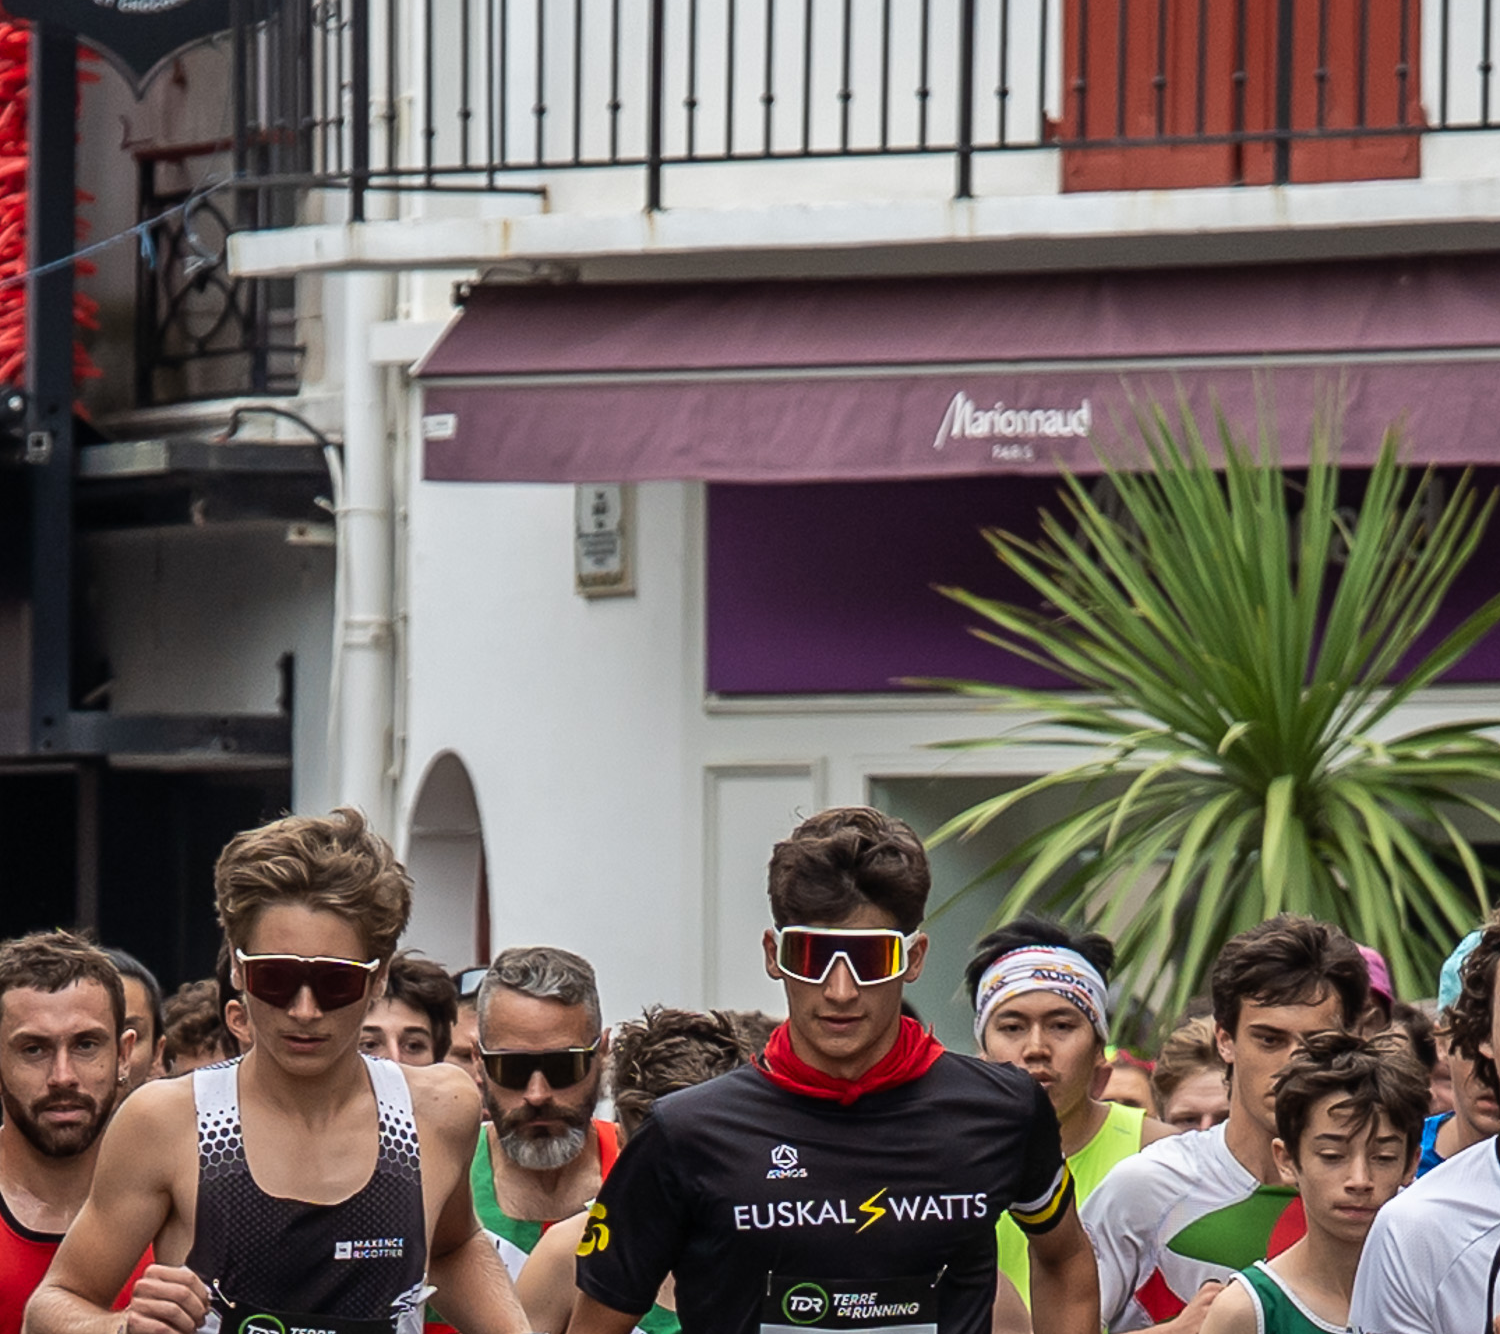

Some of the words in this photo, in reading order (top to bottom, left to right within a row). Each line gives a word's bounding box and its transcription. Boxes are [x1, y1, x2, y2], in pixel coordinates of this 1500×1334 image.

[933, 391, 1092, 450] Marionnaud
[734, 1199, 856, 1230] EUSKAL
[888, 1193, 988, 1220] WATTS
[790, 1296, 823, 1312] TDR
[833, 1293, 877, 1306] TERRE
[851, 1303, 920, 1319] RUNNING
